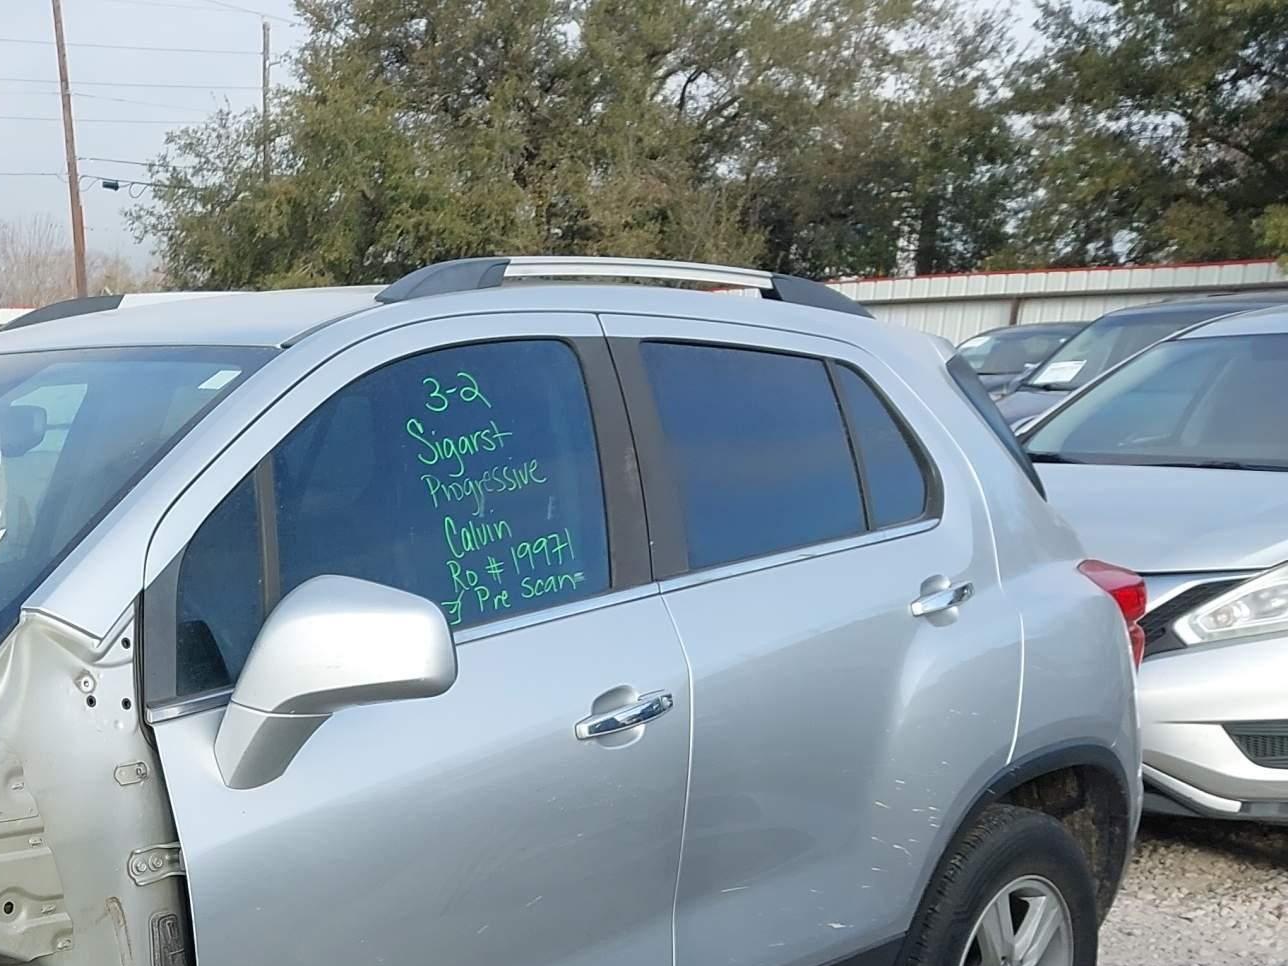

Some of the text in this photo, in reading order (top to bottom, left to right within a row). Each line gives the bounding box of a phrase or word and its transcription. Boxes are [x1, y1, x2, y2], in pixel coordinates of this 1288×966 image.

[423, 372, 492, 412] 3-2
[420, 458, 548, 516] Progressive
[444, 515, 513, 559] Calvin
[511, 527, 575, 575] 19971
[474, 586, 512, 613] Pre
